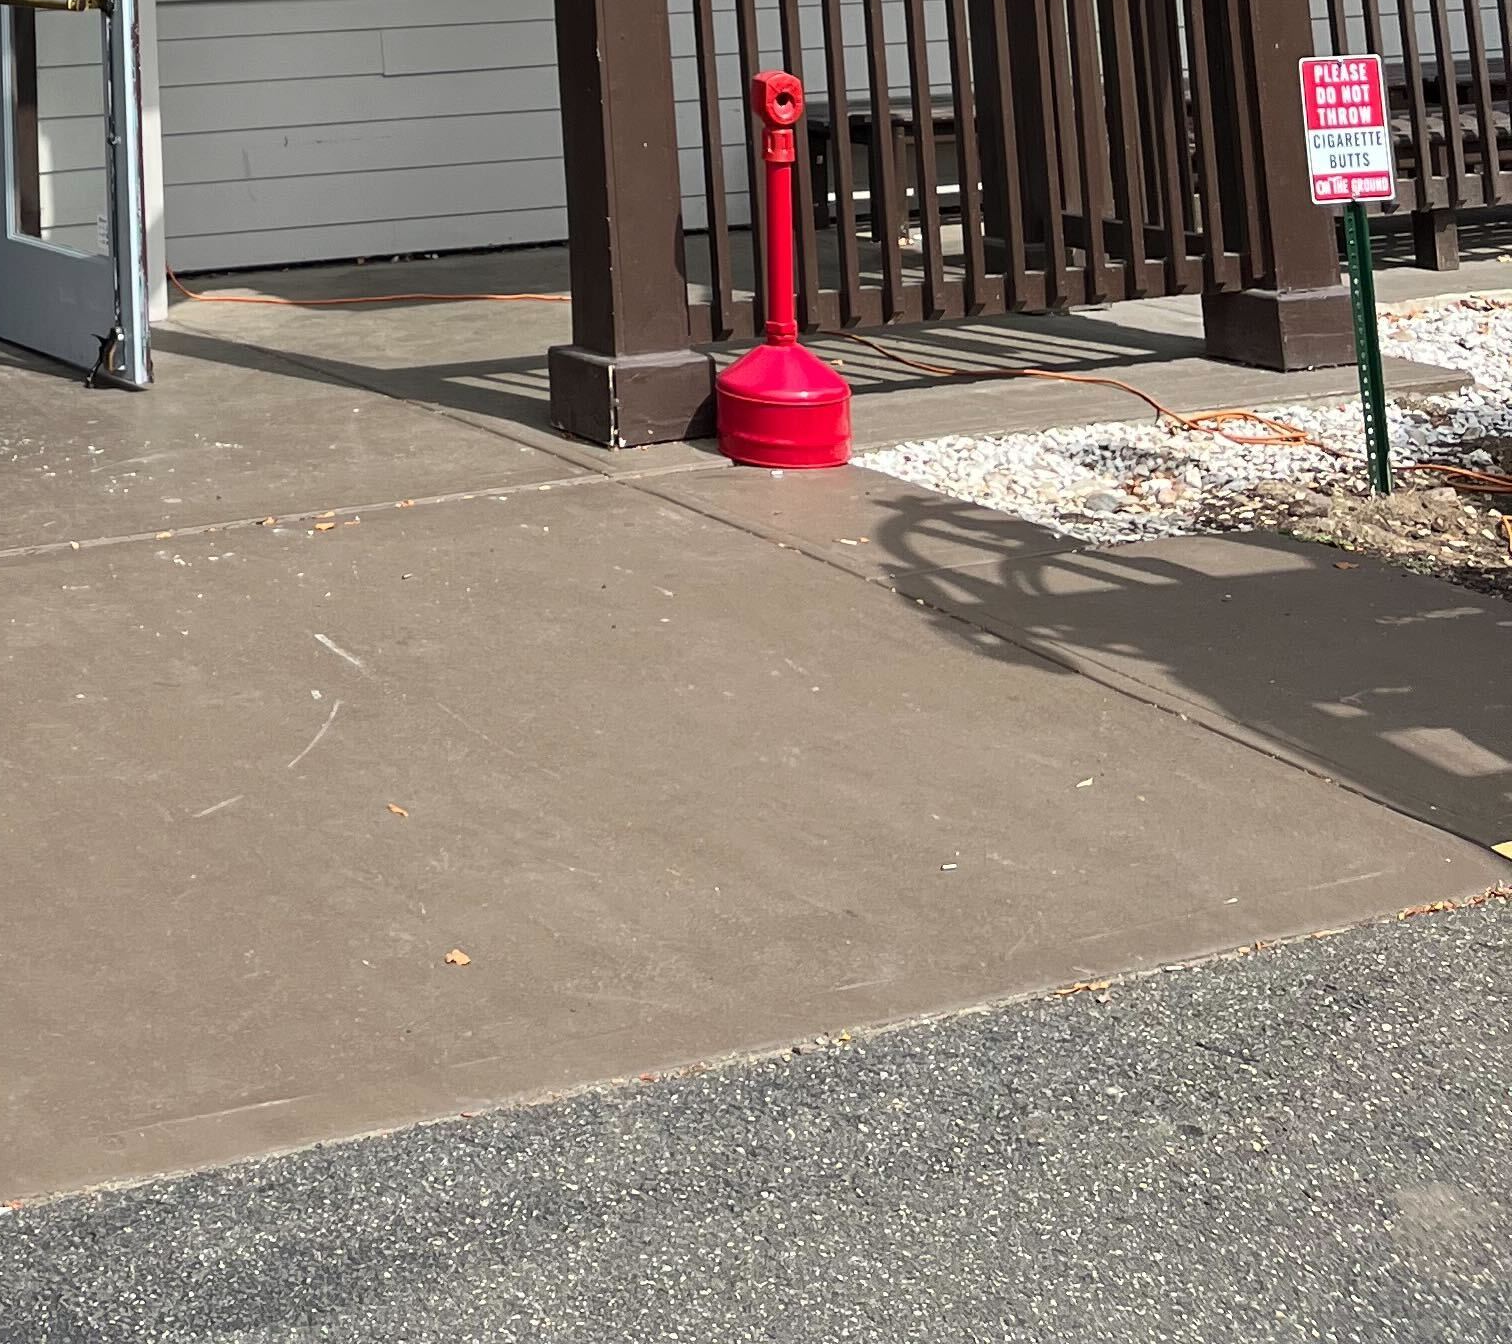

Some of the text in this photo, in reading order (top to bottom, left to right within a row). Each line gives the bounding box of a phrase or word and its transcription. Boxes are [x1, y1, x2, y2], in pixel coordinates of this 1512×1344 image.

[1314, 63, 1368, 83] PLEASE
[1316, 84, 1370, 105] DO NOT
[1317, 106, 1372, 126] THROW
[1313, 131, 1382, 149] CIGARETTE
[1330, 153, 1370, 169] BUTTS
[1315, 176, 1389, 195] ON THE GROUND
